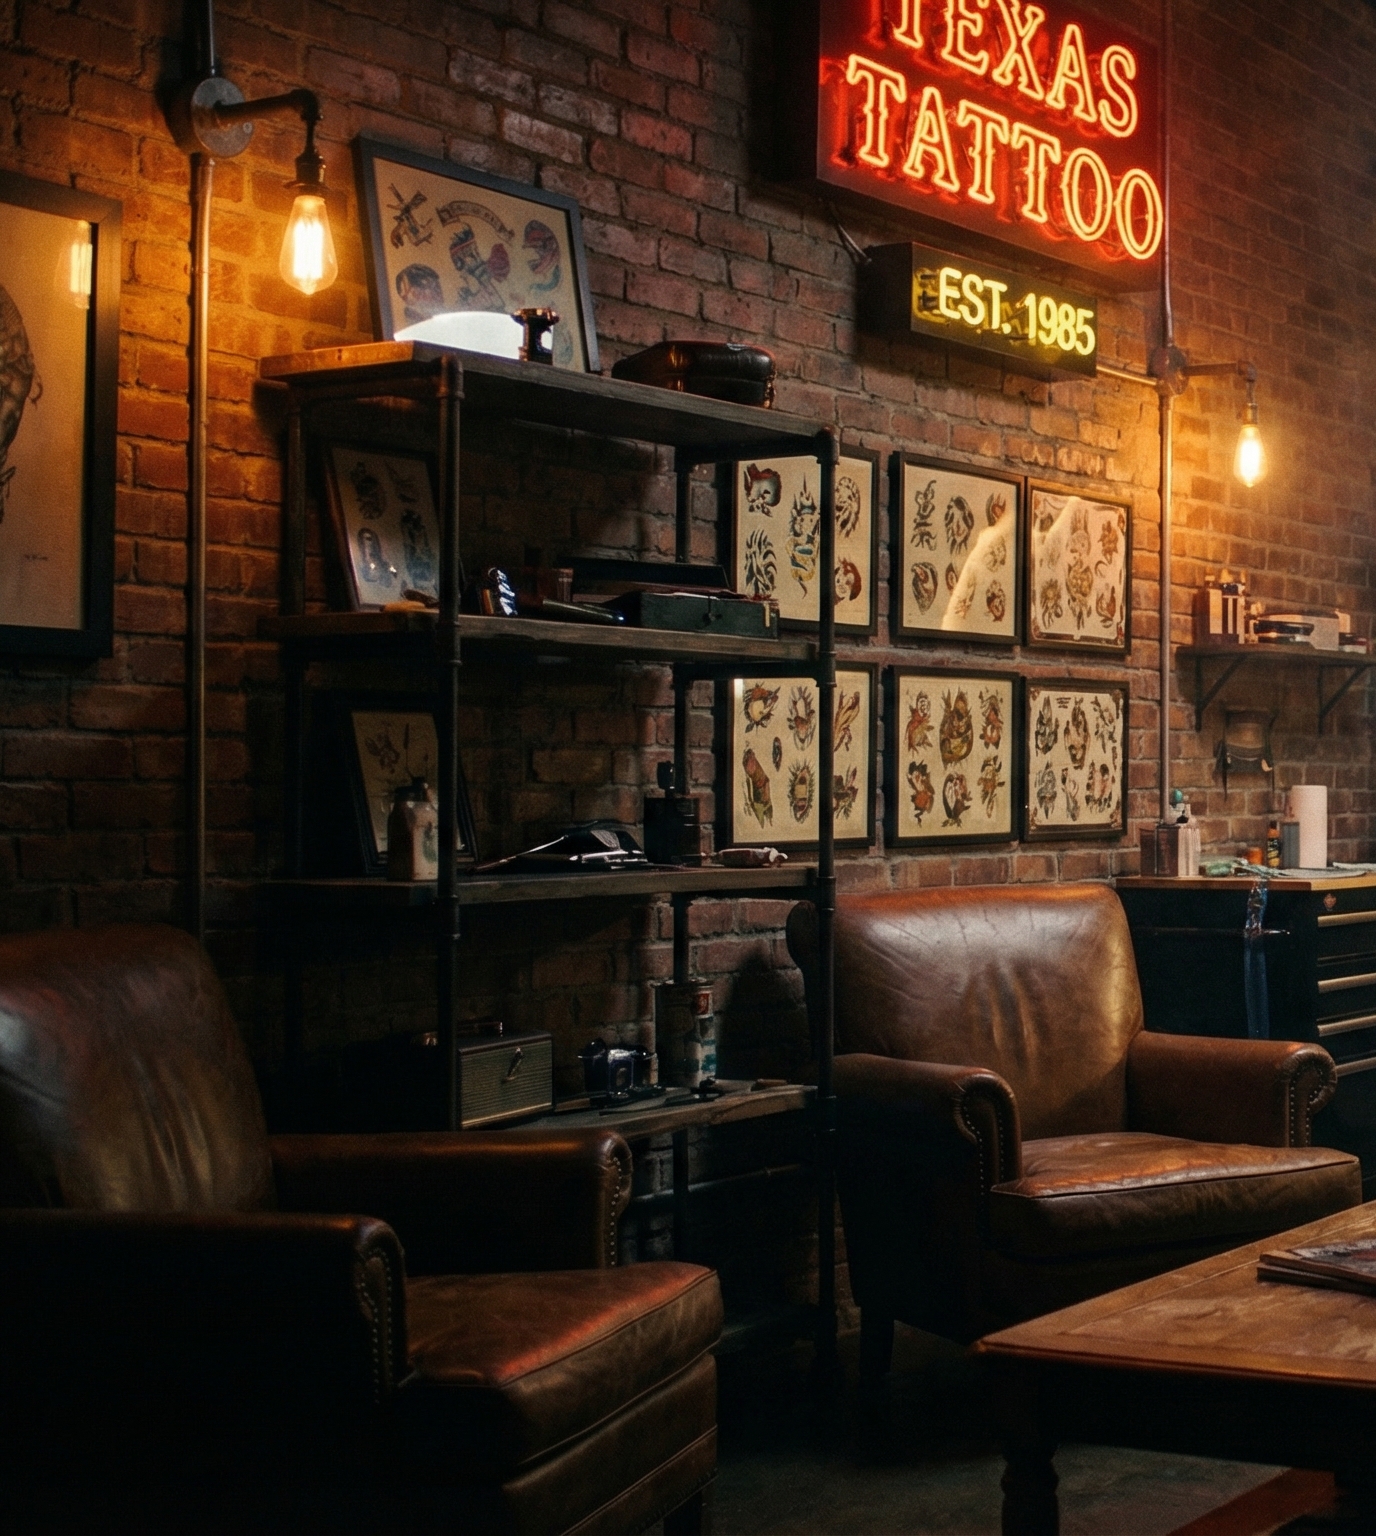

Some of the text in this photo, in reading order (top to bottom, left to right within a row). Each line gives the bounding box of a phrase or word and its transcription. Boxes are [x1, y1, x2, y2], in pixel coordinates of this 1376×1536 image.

[846, 54, 1163, 260] TATTOO
[939, 266, 1096, 356] EST. 1985
